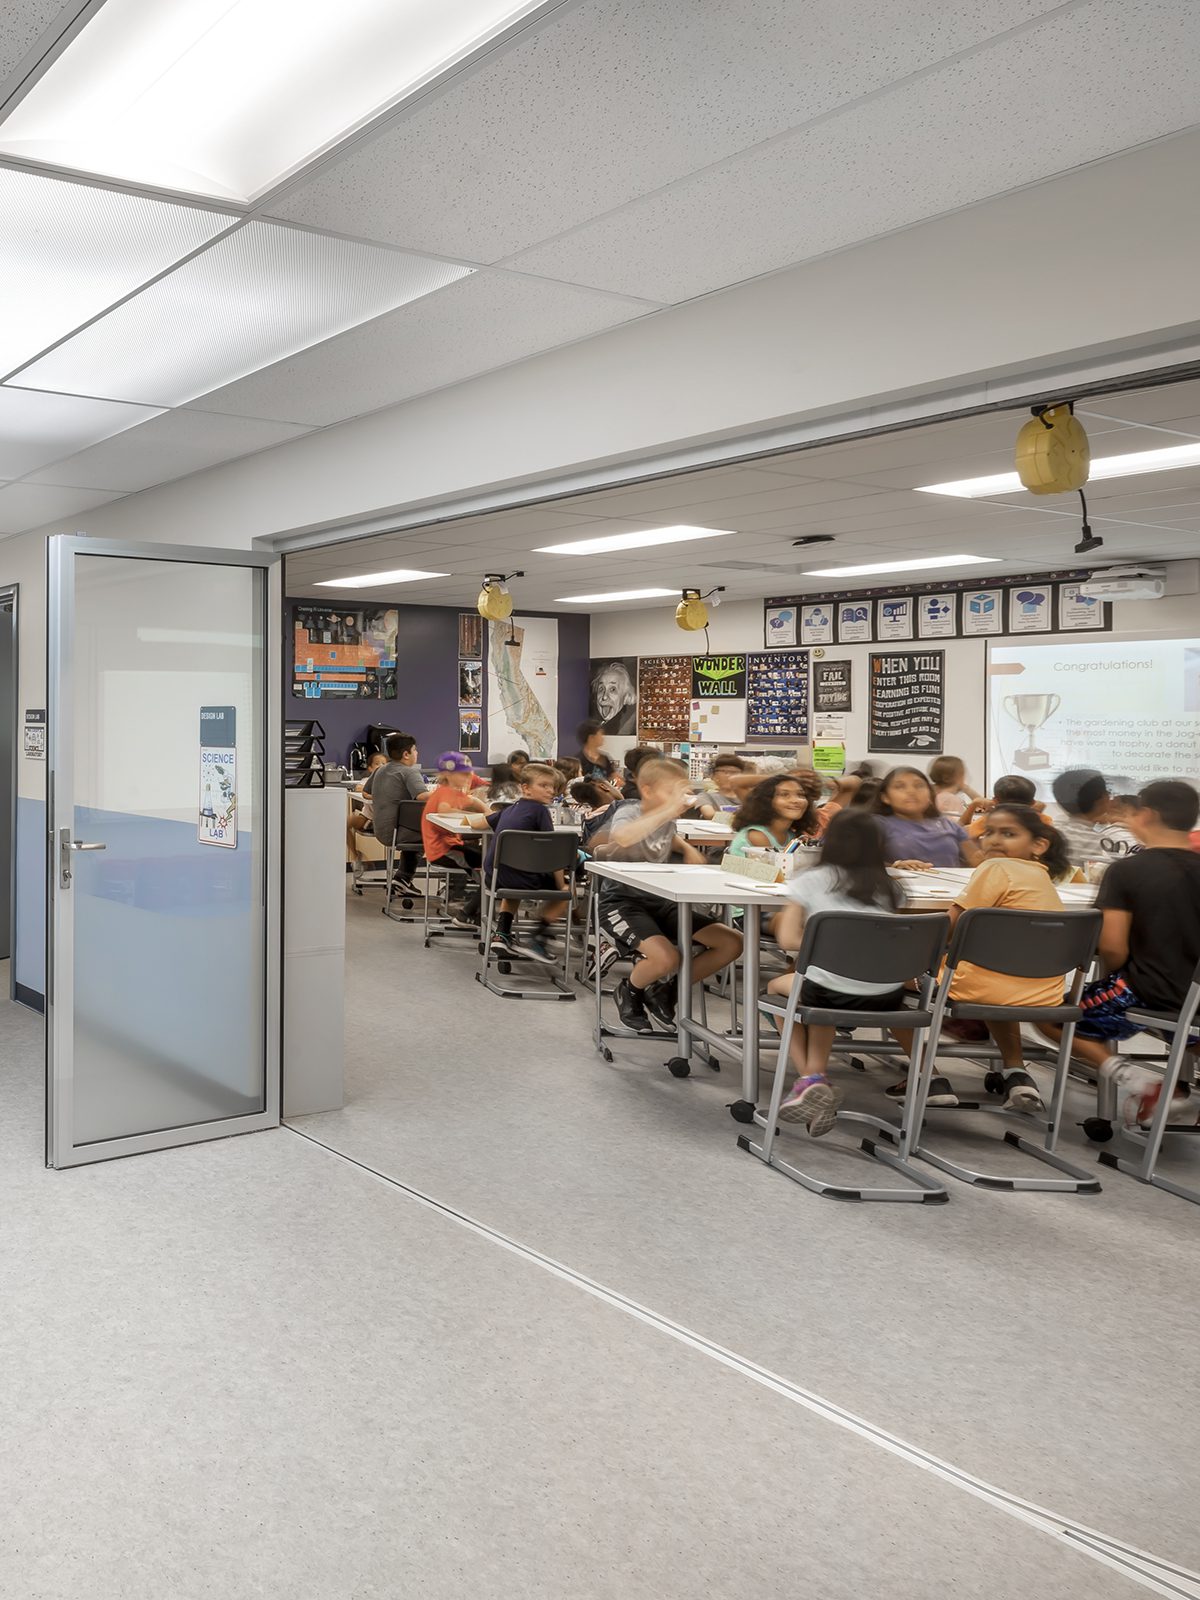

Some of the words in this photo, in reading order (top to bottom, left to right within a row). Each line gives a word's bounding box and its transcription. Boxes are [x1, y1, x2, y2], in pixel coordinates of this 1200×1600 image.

[693, 656, 744, 671] WONDER
[748, 654, 808, 664] INVENTORS
[873, 657, 908, 674] WHEN
[913, 656, 940, 670] YOU
[1053, 659, 1153, 673] Congratulations!
[823, 671, 843, 681] FAIL
[873, 676, 896, 686] ENTER
[899, 674, 917, 684] THIS
[919, 673, 940, 682] ROOM
[698, 680, 738, 696] WALL
[873, 687, 909, 698] LEARNING
[911, 685, 919, 694] IS
[921, 684, 940, 694] FUN!
[818, 692, 848, 704] TRYING
[873, 700, 906, 708] COOPERATION
[913, 696, 940, 704] EXPECTED
[883, 710, 904, 718] POSITIVE
[905, 706, 928, 714] ATTITUDE
[929, 706, 940, 714] AND
[890, 718, 910, 726] RESPECT
[1084, 719, 1134, 728] gardening
[1108, 730, 1142, 738] money
[1175, 730, 1200, 739] Jog-
[1119, 740, 1152, 749] trophy,
[1166, 740, 1196, 748] donut
[202, 752, 234, 764] SCIENCE
[1124, 750, 1171, 758] decorate
[210, 828, 224, 838] LAB
